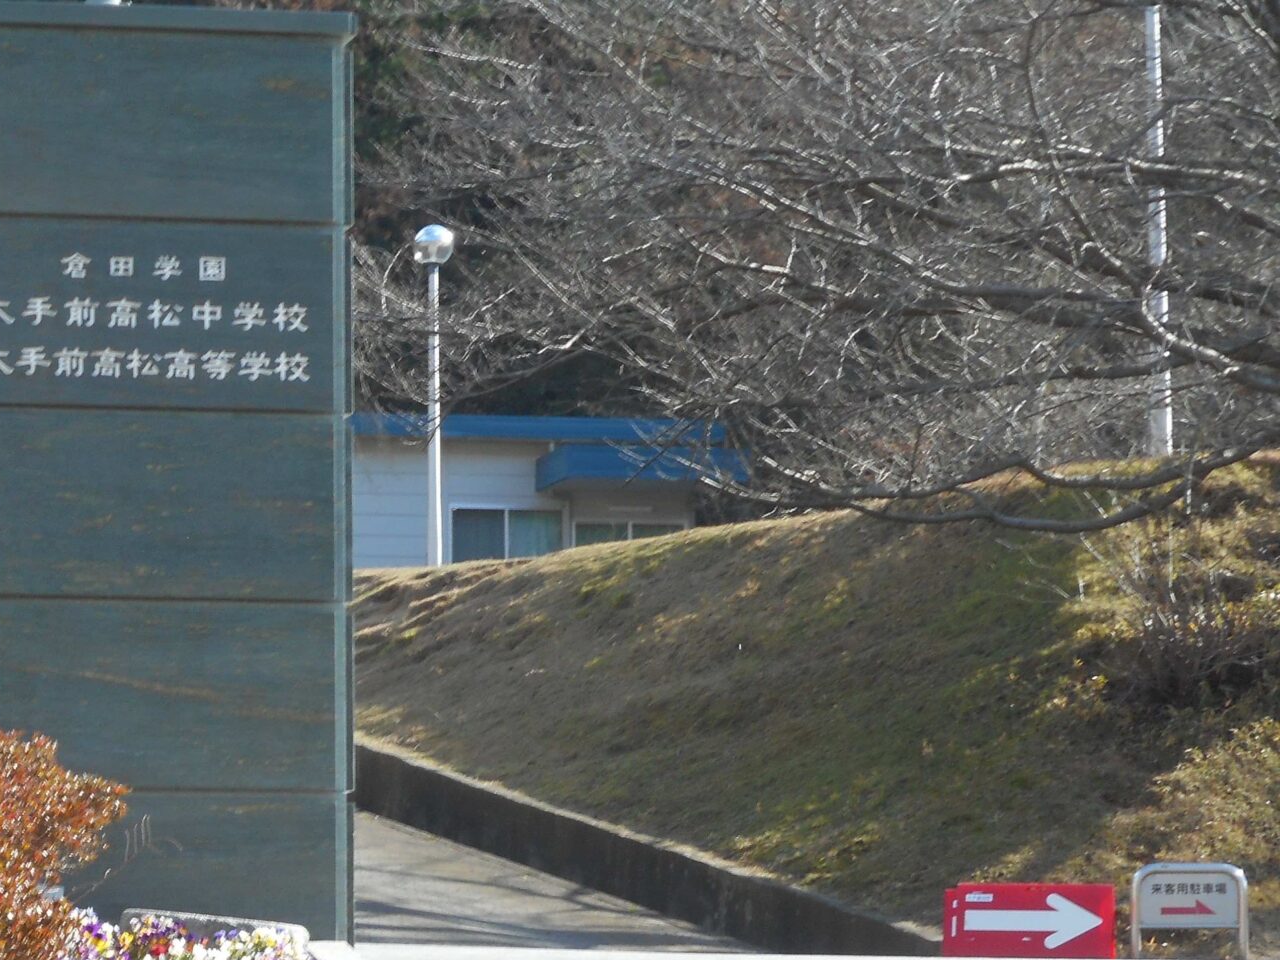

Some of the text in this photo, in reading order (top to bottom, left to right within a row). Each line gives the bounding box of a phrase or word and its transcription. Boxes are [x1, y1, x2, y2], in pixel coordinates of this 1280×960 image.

[60, 252, 227, 282] 倉田学園
[1151, 883, 1227, 895] 来客用駐車場
